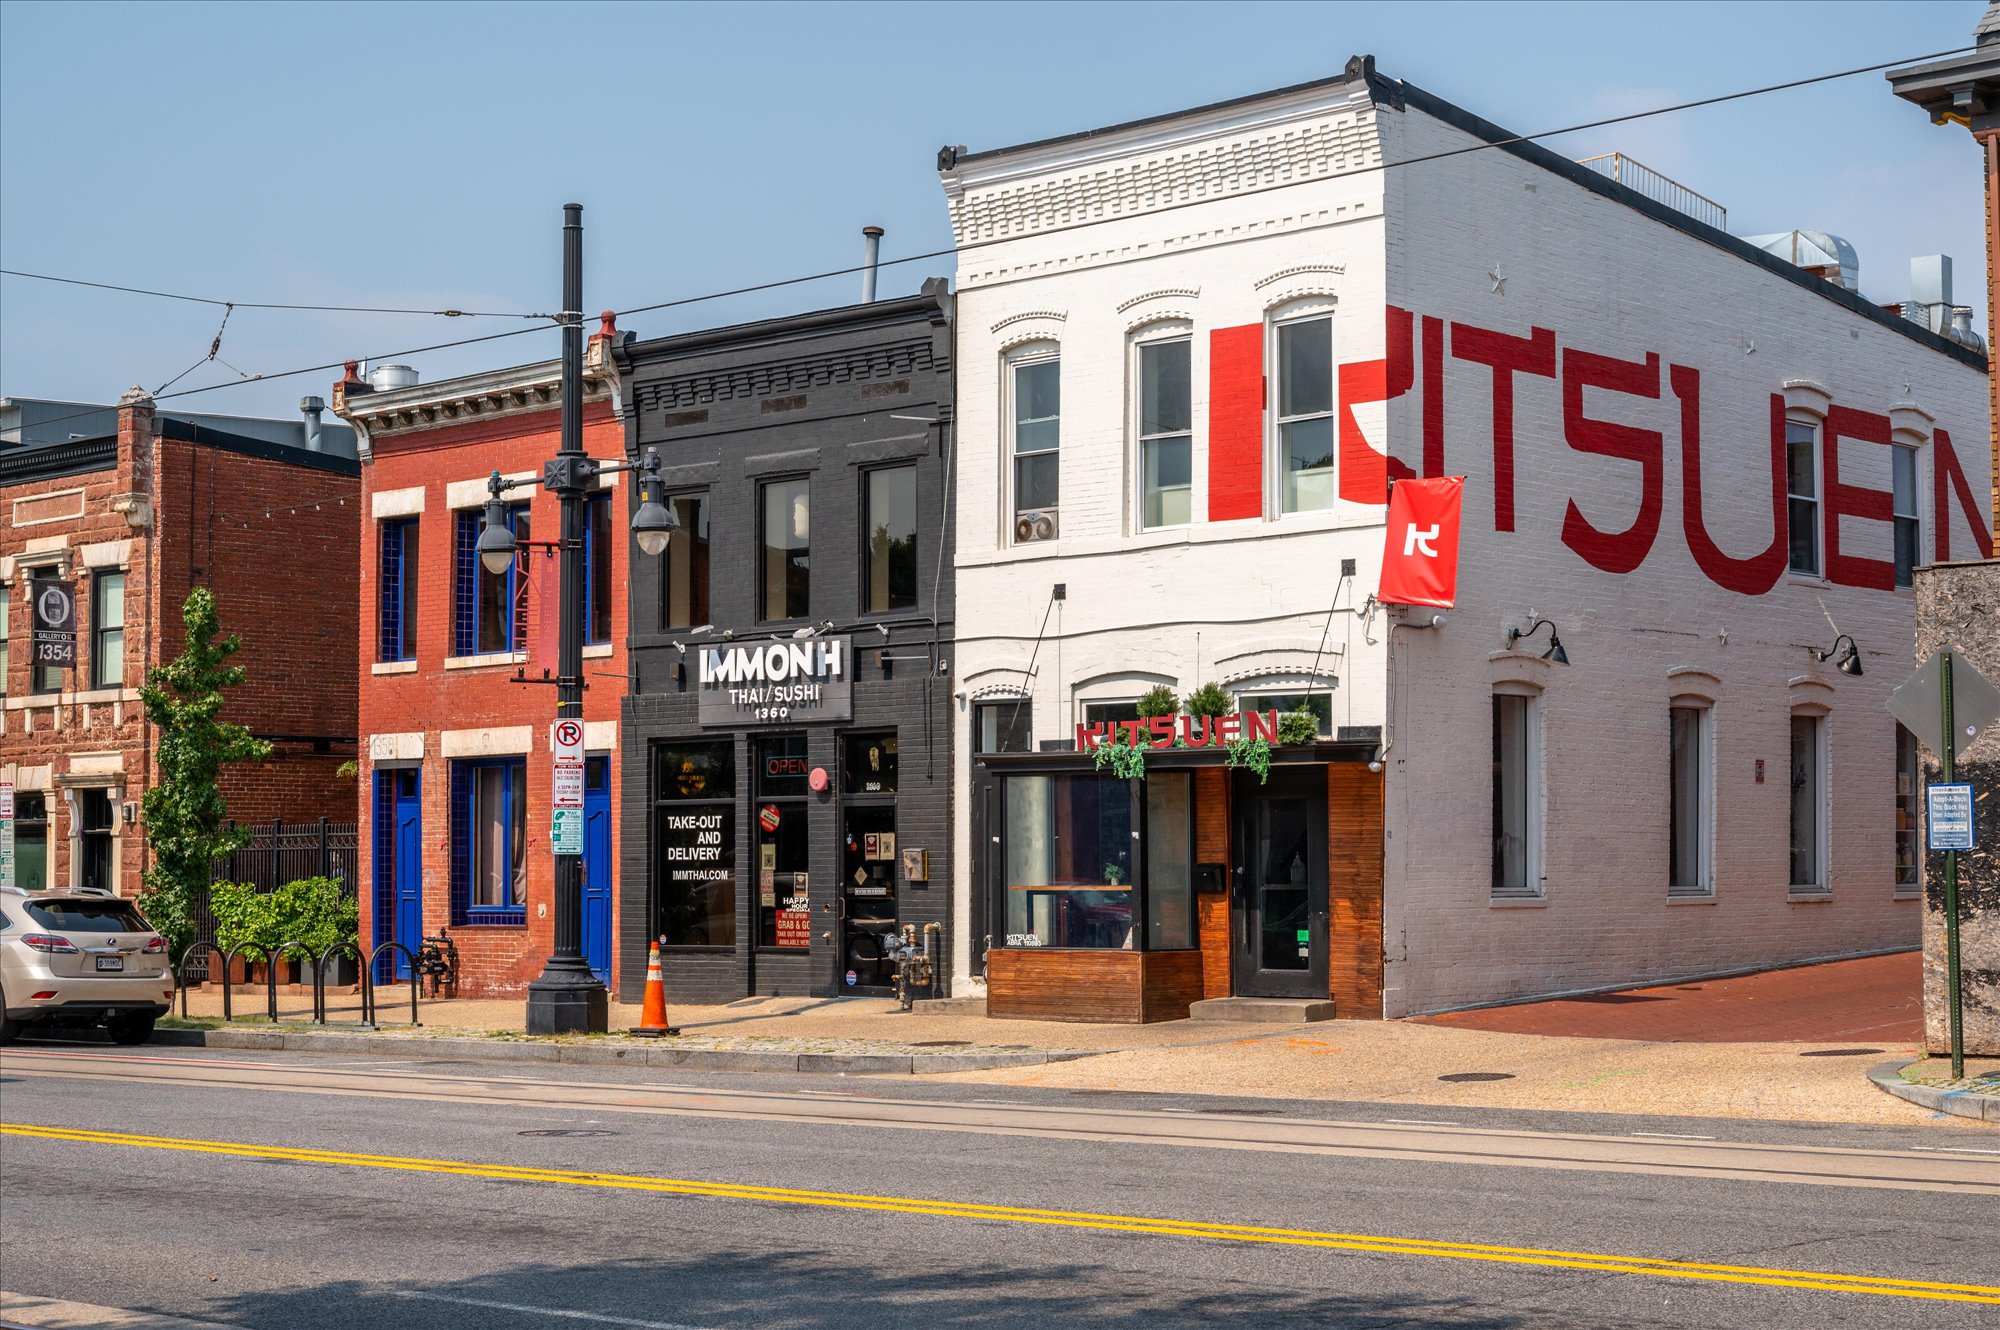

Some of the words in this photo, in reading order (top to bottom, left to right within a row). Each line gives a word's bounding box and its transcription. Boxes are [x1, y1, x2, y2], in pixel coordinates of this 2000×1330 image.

[1403, 522, 1440, 558] K
[38, 632, 60, 640] GALLERY
[38, 643, 73, 661] 1354
[754, 706, 788, 720] 1360
[768, 759, 808, 775] OPEN
[1932, 803, 1943, 811] This
[1943, 803, 1957, 811] Block
[1958, 803, 1968, 811] Has
[1944, 811, 1960, 819] Adopted
[667, 815, 722, 829] TAKE-OUT
[697, 832, 721, 845] AND
[667, 847, 721, 861] DELIVERY
[672, 870, 728, 881] IMMTHAI.COM
[783, 897, 810, 905] HAPPY
[777, 920, 794, 930] GRAB
[795, 920, 801, 929] &
[776, 930, 786, 938] TAKE
